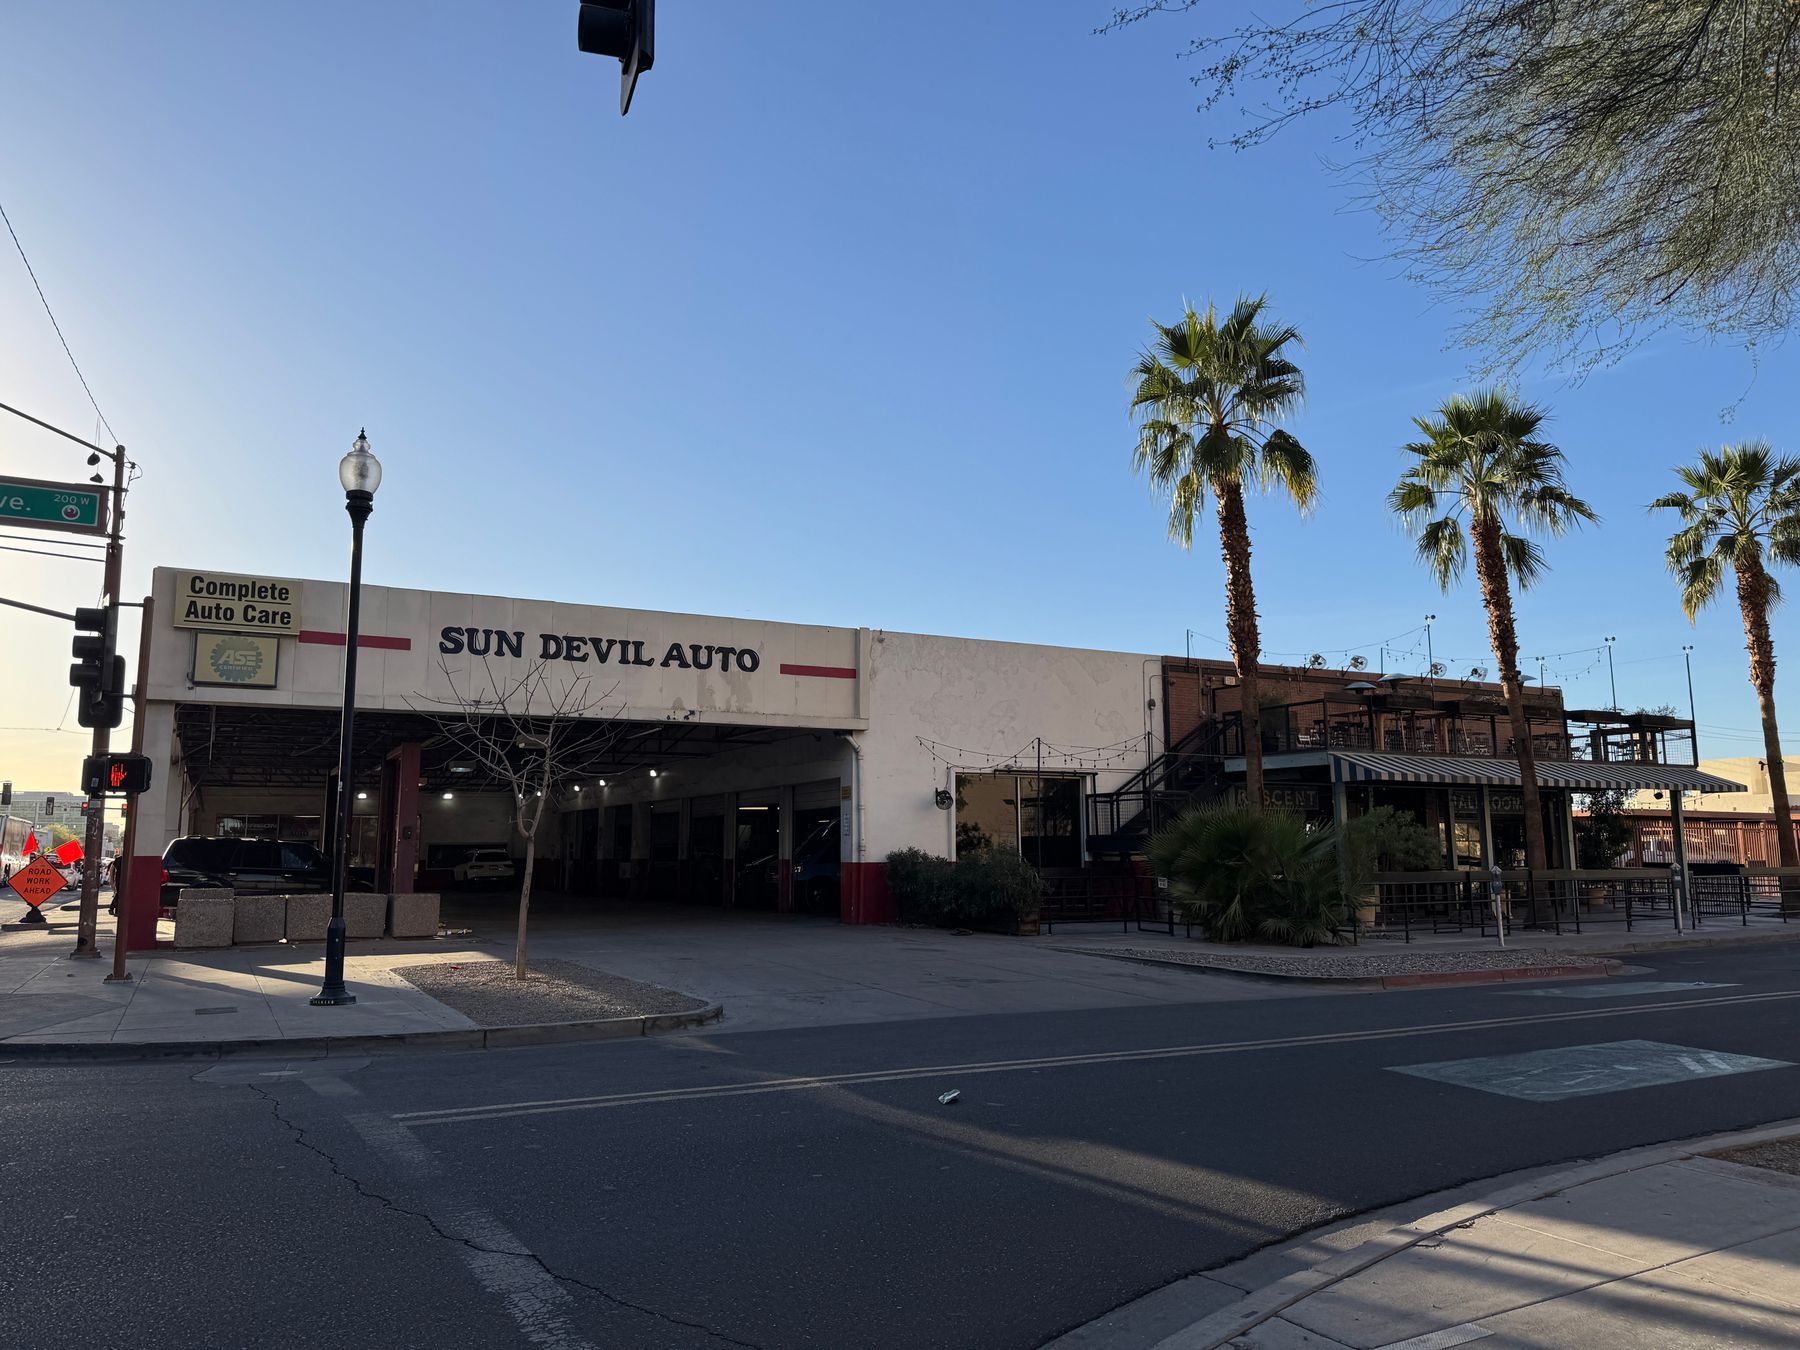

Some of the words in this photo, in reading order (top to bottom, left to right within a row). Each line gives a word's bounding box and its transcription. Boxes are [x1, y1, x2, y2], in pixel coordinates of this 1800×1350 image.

[54, 494, 77, 504] 200
[80, 497, 90, 505] W
[190, 575, 290, 601] Complete
[185, 600, 235, 621] Auto
[243, 604, 292, 625] Care
[218, 649, 257, 666] ASE
[439, 626, 525, 658] SUN
[539, 633, 655, 667] DEVIL
[660, 642, 760, 673] AUTO
[1235, 788, 1317, 806] RSCENT
[26, 877, 50, 885] WORK
